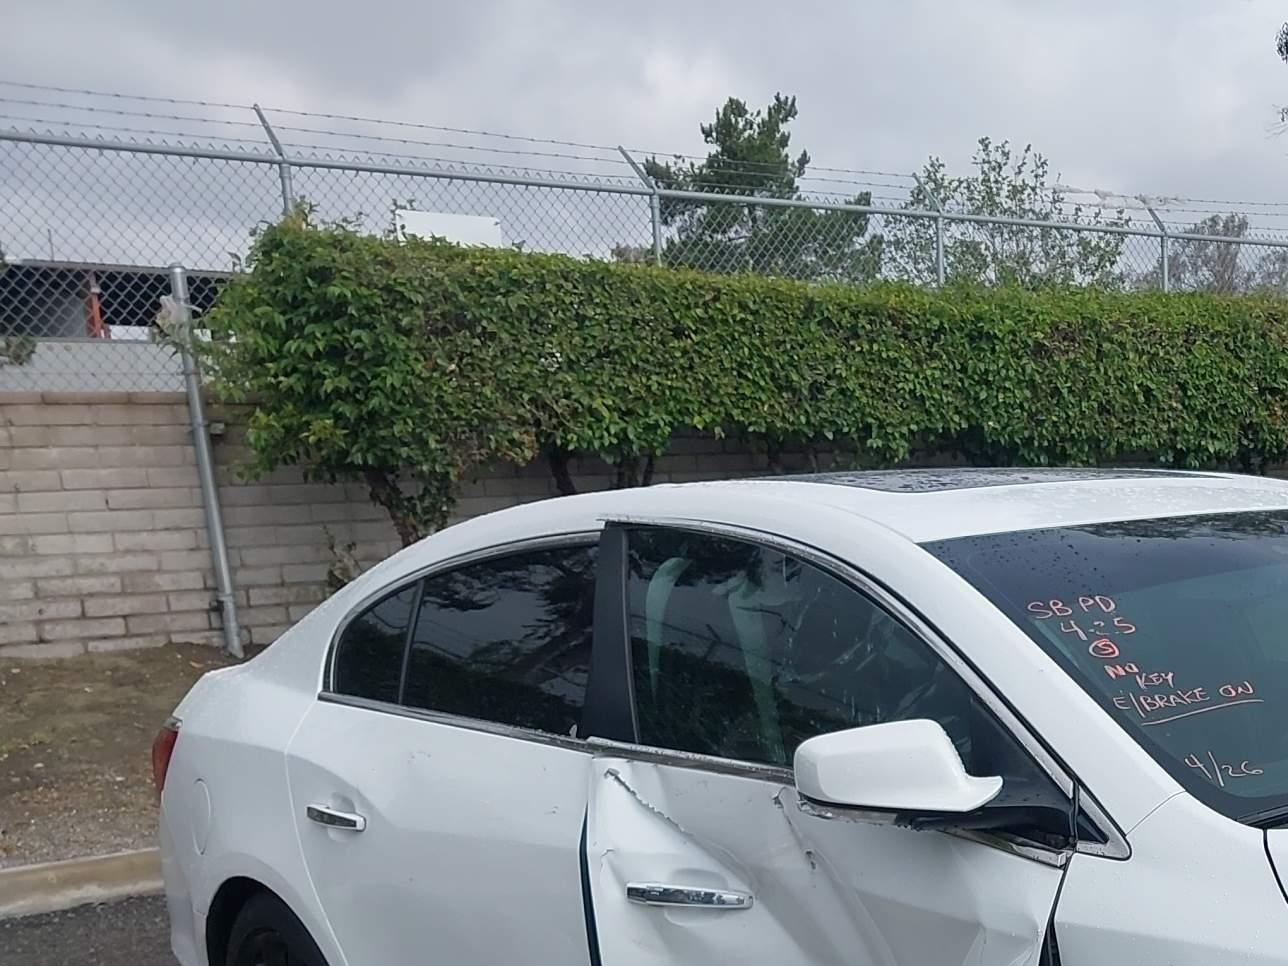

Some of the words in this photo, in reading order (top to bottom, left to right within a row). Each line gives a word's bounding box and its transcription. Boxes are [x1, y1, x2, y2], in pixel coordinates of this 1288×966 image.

[1027, 600, 1073, 619] SB
[1079, 595, 1116, 613] PD
[1104, 663, 1139, 679] NO
[1135, 671, 1174, 689] KEY
[1219, 681, 1254, 697] ON
[1184, 751, 1264, 788] 4/26
